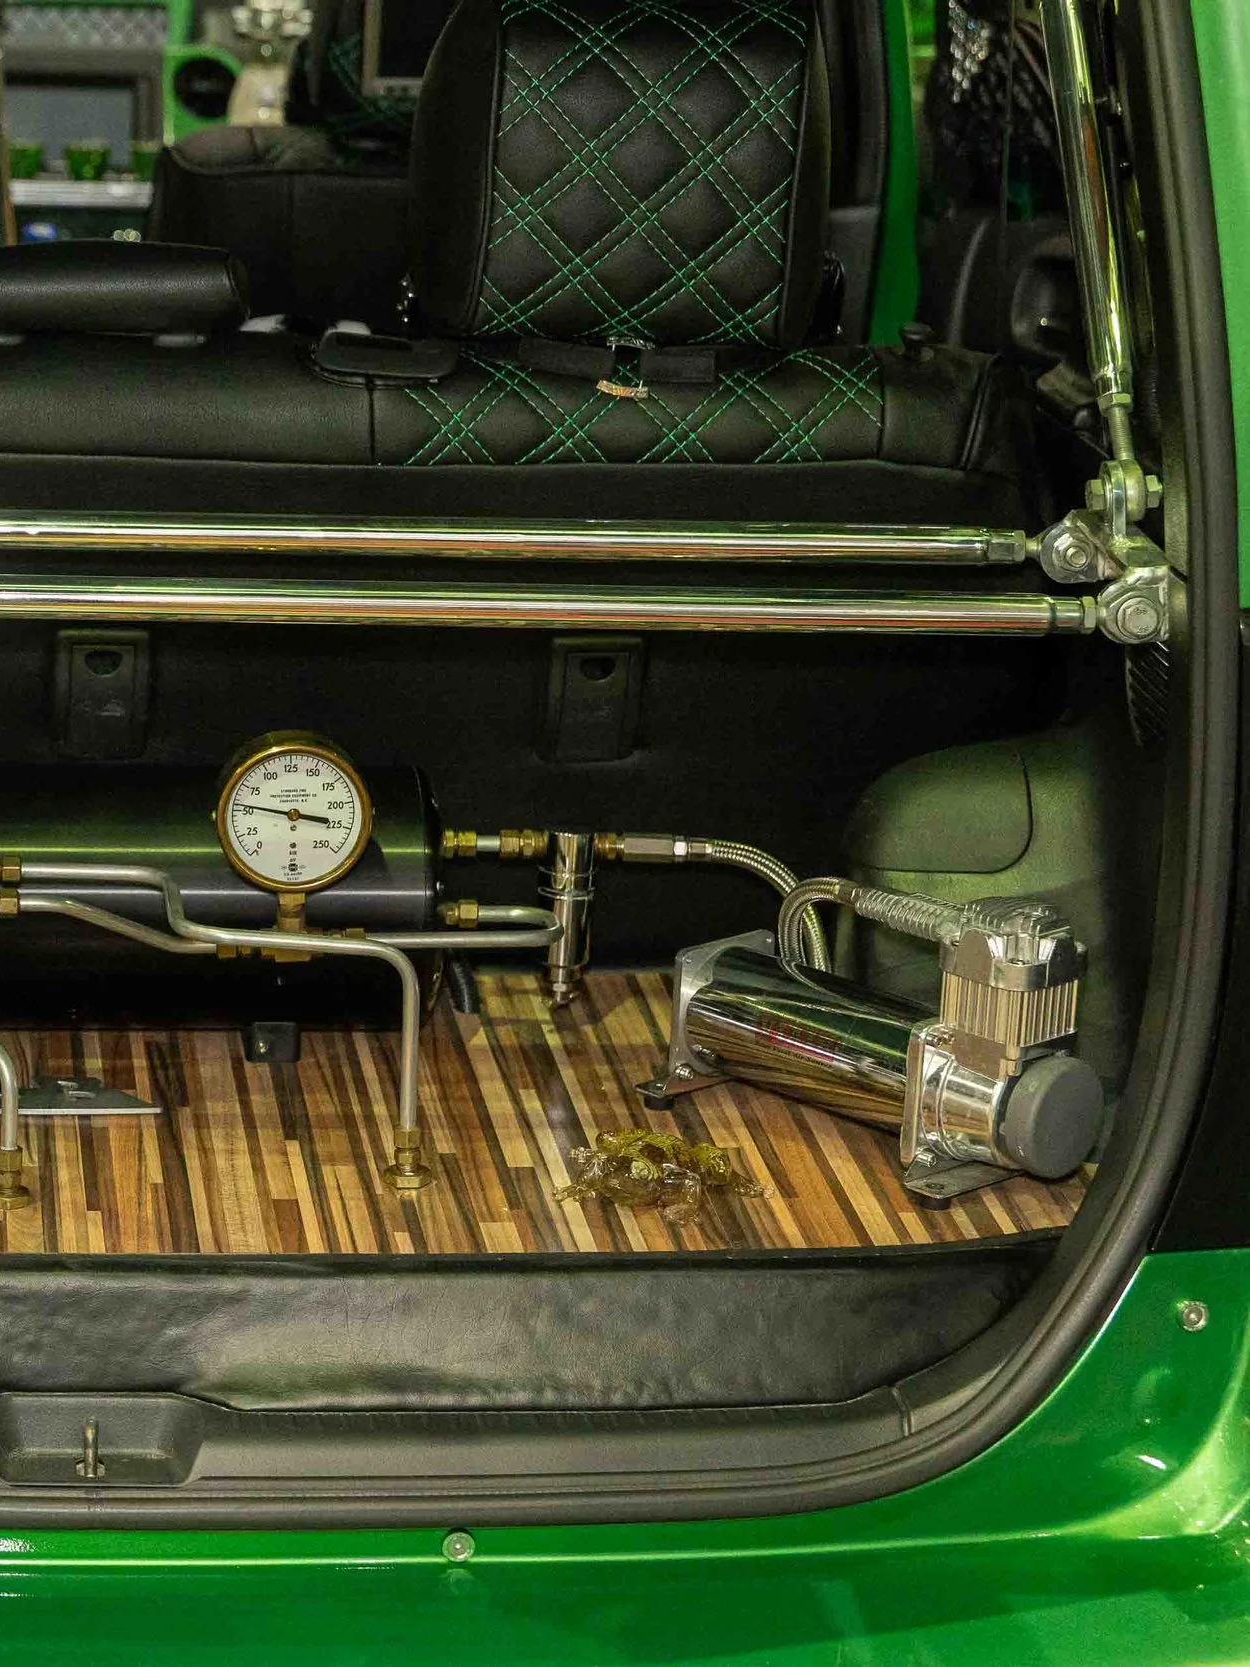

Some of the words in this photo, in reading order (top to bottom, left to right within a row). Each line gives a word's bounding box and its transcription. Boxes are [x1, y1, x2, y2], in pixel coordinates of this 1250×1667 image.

[284, 765, 298, 773] 125
[306, 769, 320, 777] 150
[263, 772, 278, 780] 100
[322, 783, 335, 791] 175
[250, 787, 261, 796] 75
[328, 801, 344, 809] 200
[242, 807, 253, 815] 50
[326, 820, 342, 829] 225
[247, 828, 258, 836] 25
[257, 841, 263, 849] 0
[313, 840, 329, 849] 250
